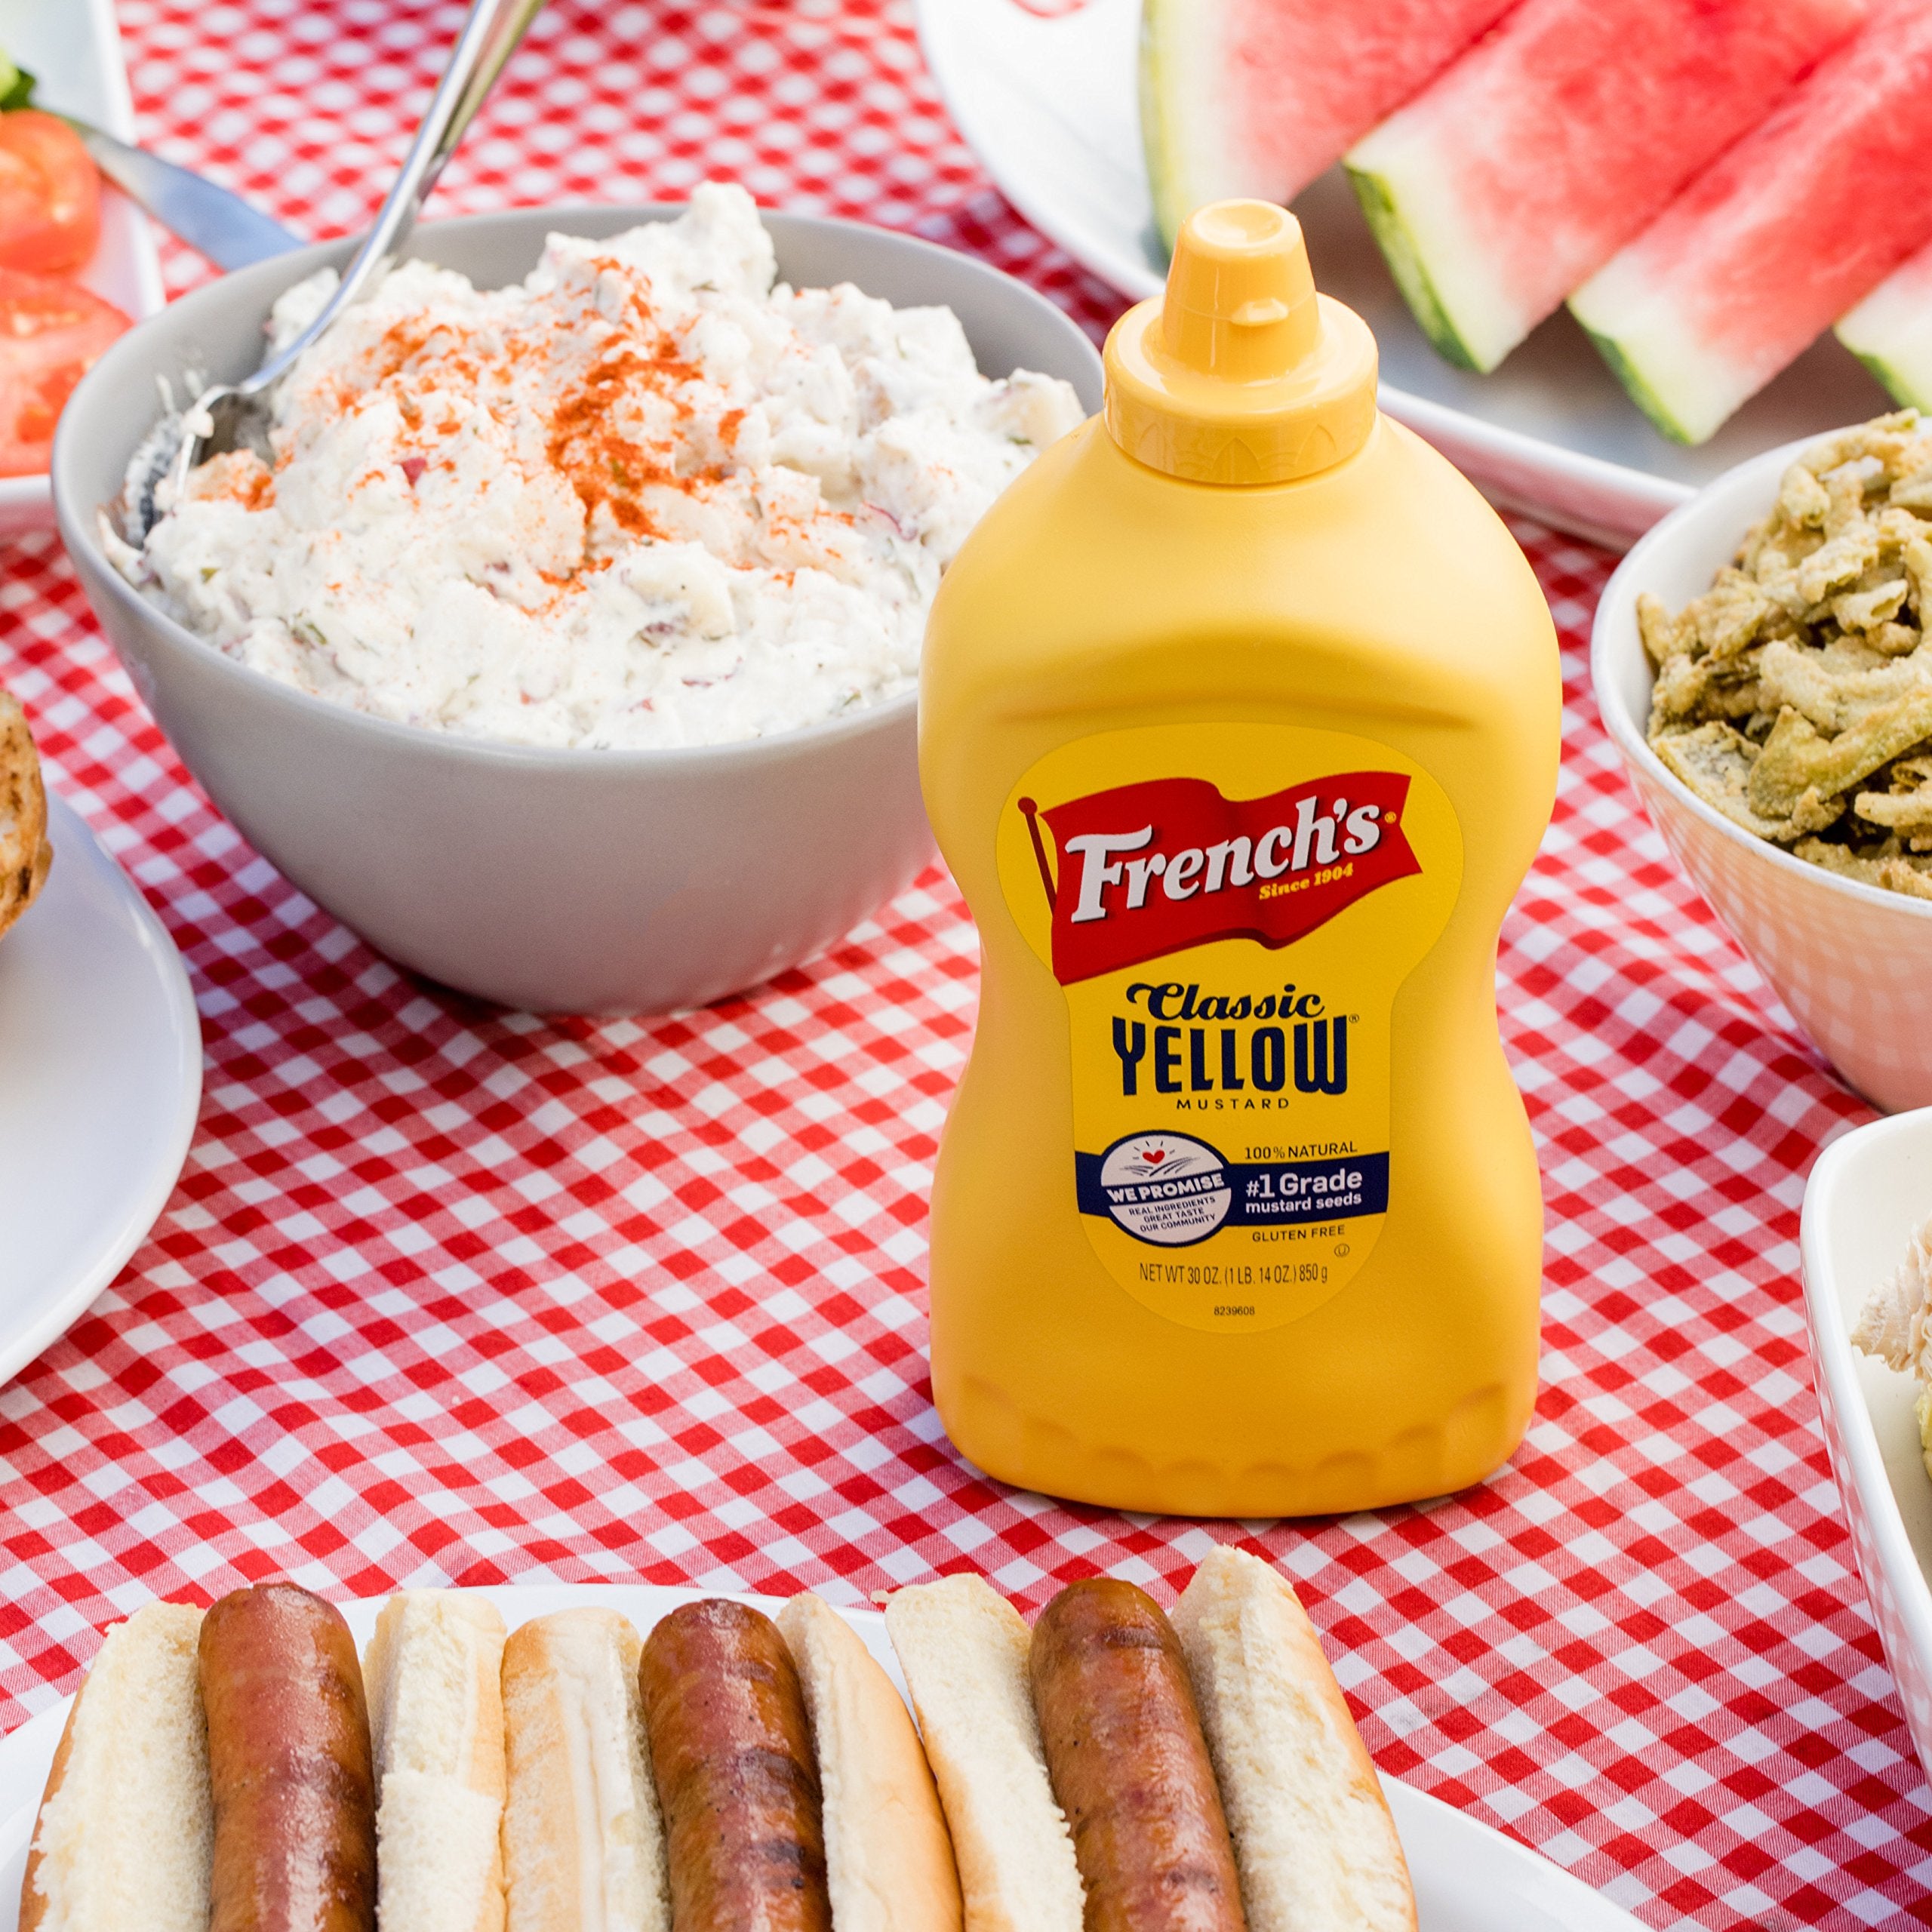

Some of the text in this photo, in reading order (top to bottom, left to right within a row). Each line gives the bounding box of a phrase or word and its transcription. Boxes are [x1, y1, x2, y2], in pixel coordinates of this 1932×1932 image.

[1065, 795, 1380, 923] French's
[1259, 863, 1354, 900] Since 1904
[1126, 983, 1325, 1021] Classic
[1112, 1014, 1347, 1096] YELLOW
[1177, 1098, 1289, 1109] MUSTARD
[1244, 1141, 1358, 1159] 100% NATURAL
[1106, 1174, 1225, 1203] WE PROMISE
[1246, 1168, 1362, 1198] #1 Grade
[1129, 1196, 1215, 1216] REAL INGREDIENTS
[1246, 1192, 1362, 1214] mustard seeds
[1140, 1214, 1216, 1232] OUR COMMUNITY
[1144, 1208, 1204, 1223] GREAT TASTE
[1252, 1225, 1345, 1242] GLUTEN FREE
[1140, 1263, 1327, 1286] NET WT 30 OZ. (1 LB. 14 OZ.) 850 g
[1214, 1306, 1255, 1315] 8239608
